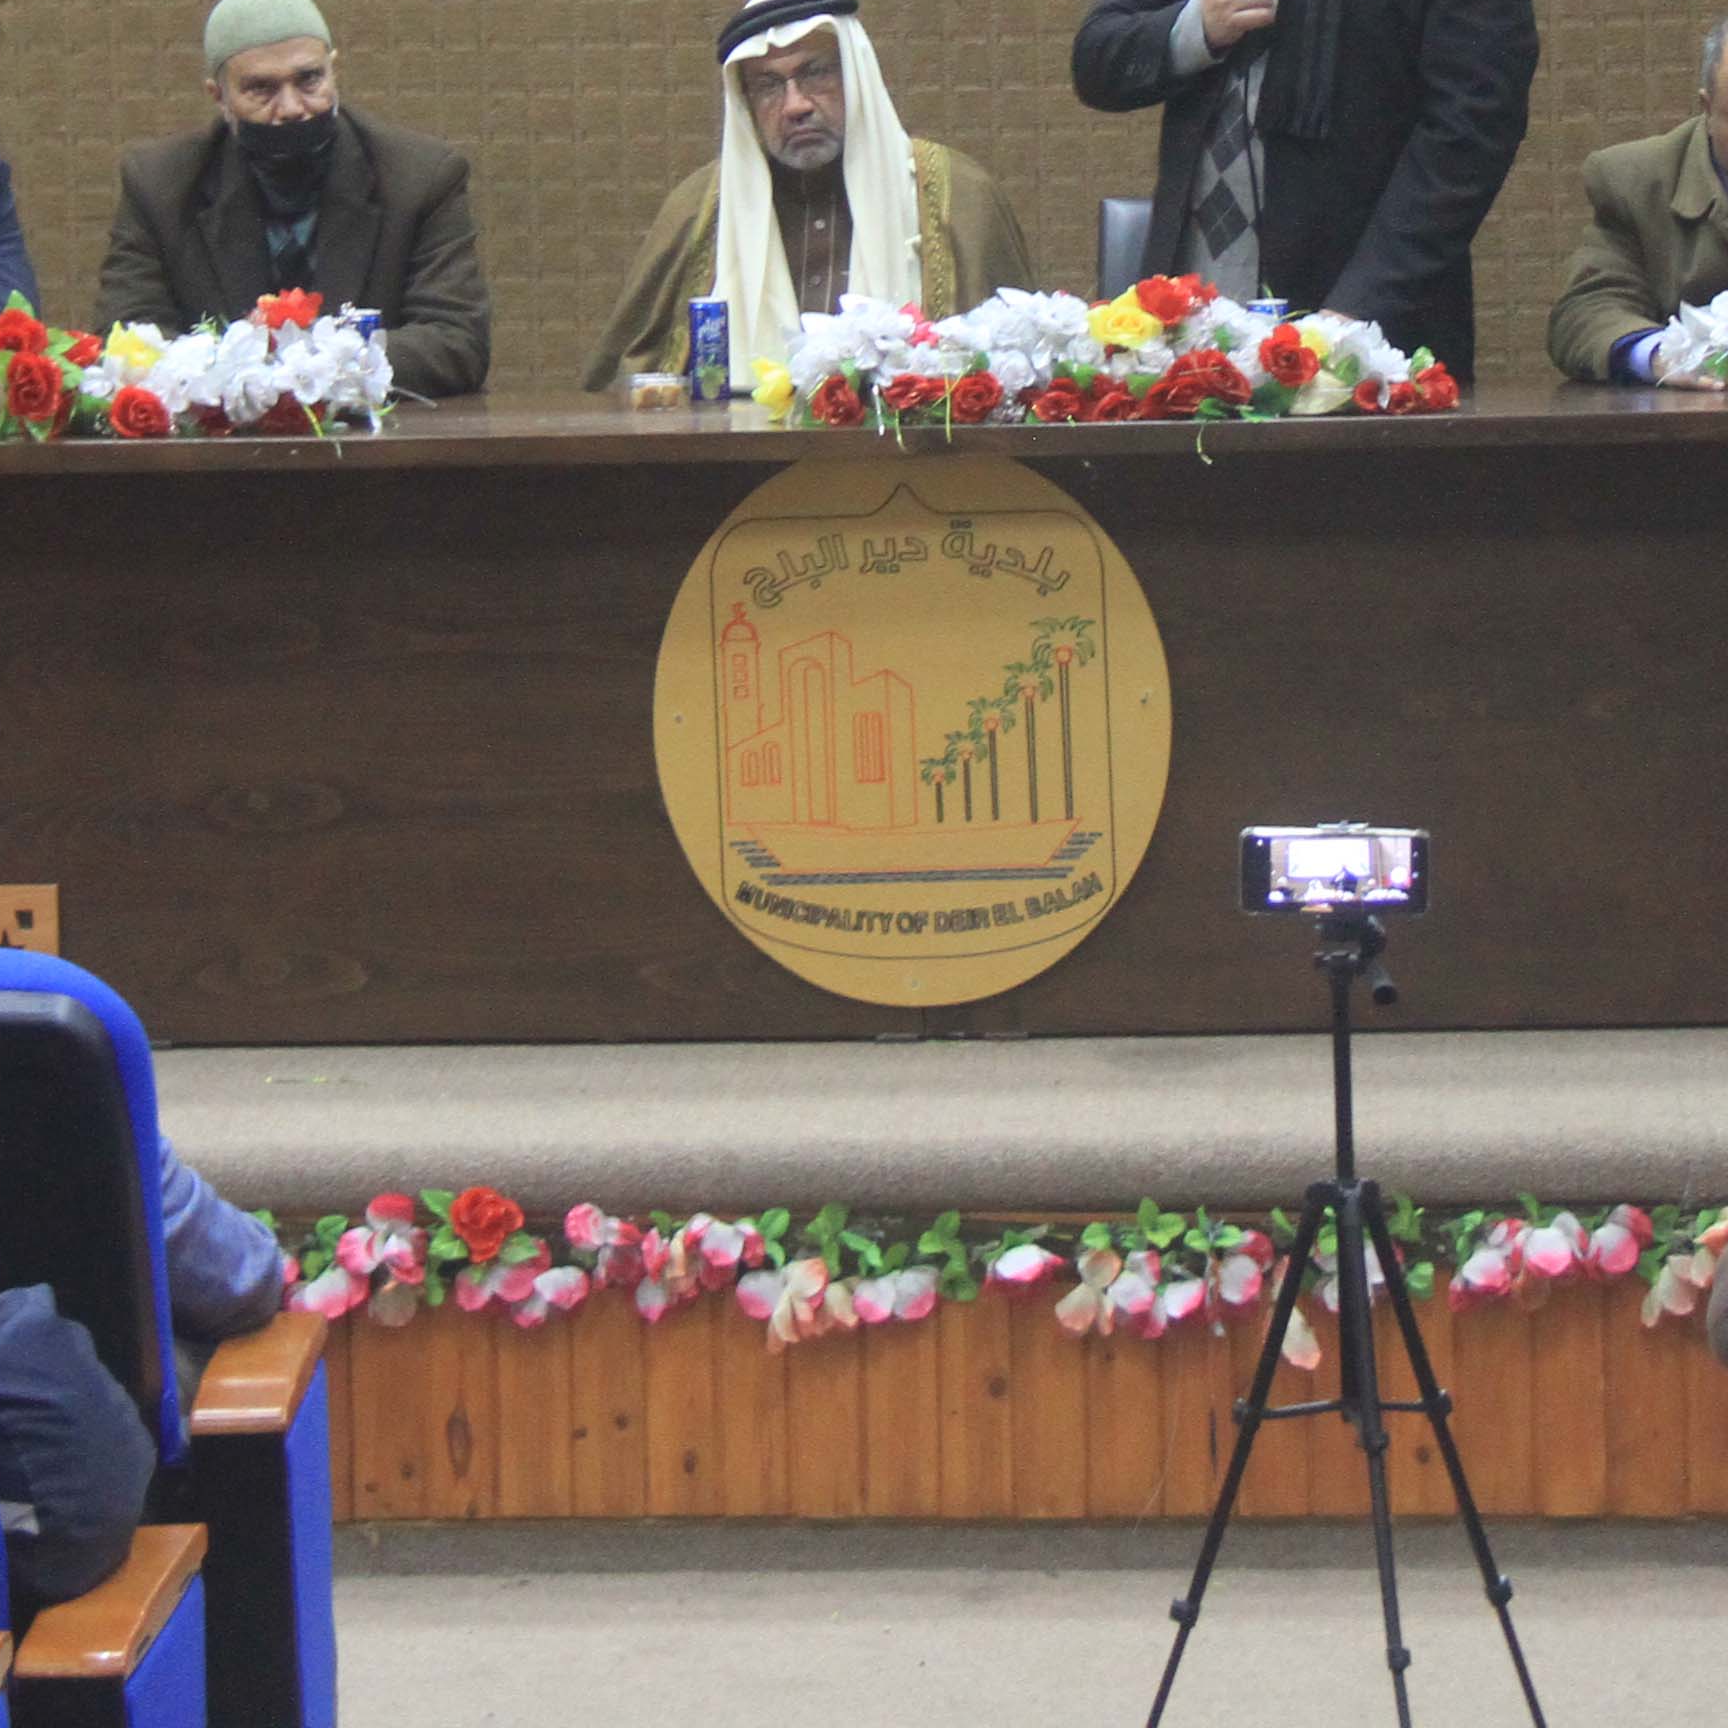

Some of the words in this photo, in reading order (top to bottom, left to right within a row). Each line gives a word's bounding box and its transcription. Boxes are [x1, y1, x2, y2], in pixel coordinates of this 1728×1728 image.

[742, 532, 849, 611] البلح
[860, 529, 929, 574] دير
[941, 519, 1071, 597] بلدية
[735, 880, 891, 935] MUNICIPALITY
[894, 910, 929, 934] OF
[933, 907, 991, 933] DEIR
[991, 901, 1024, 927] EL
[1024, 871, 1105, 920] BALAH
